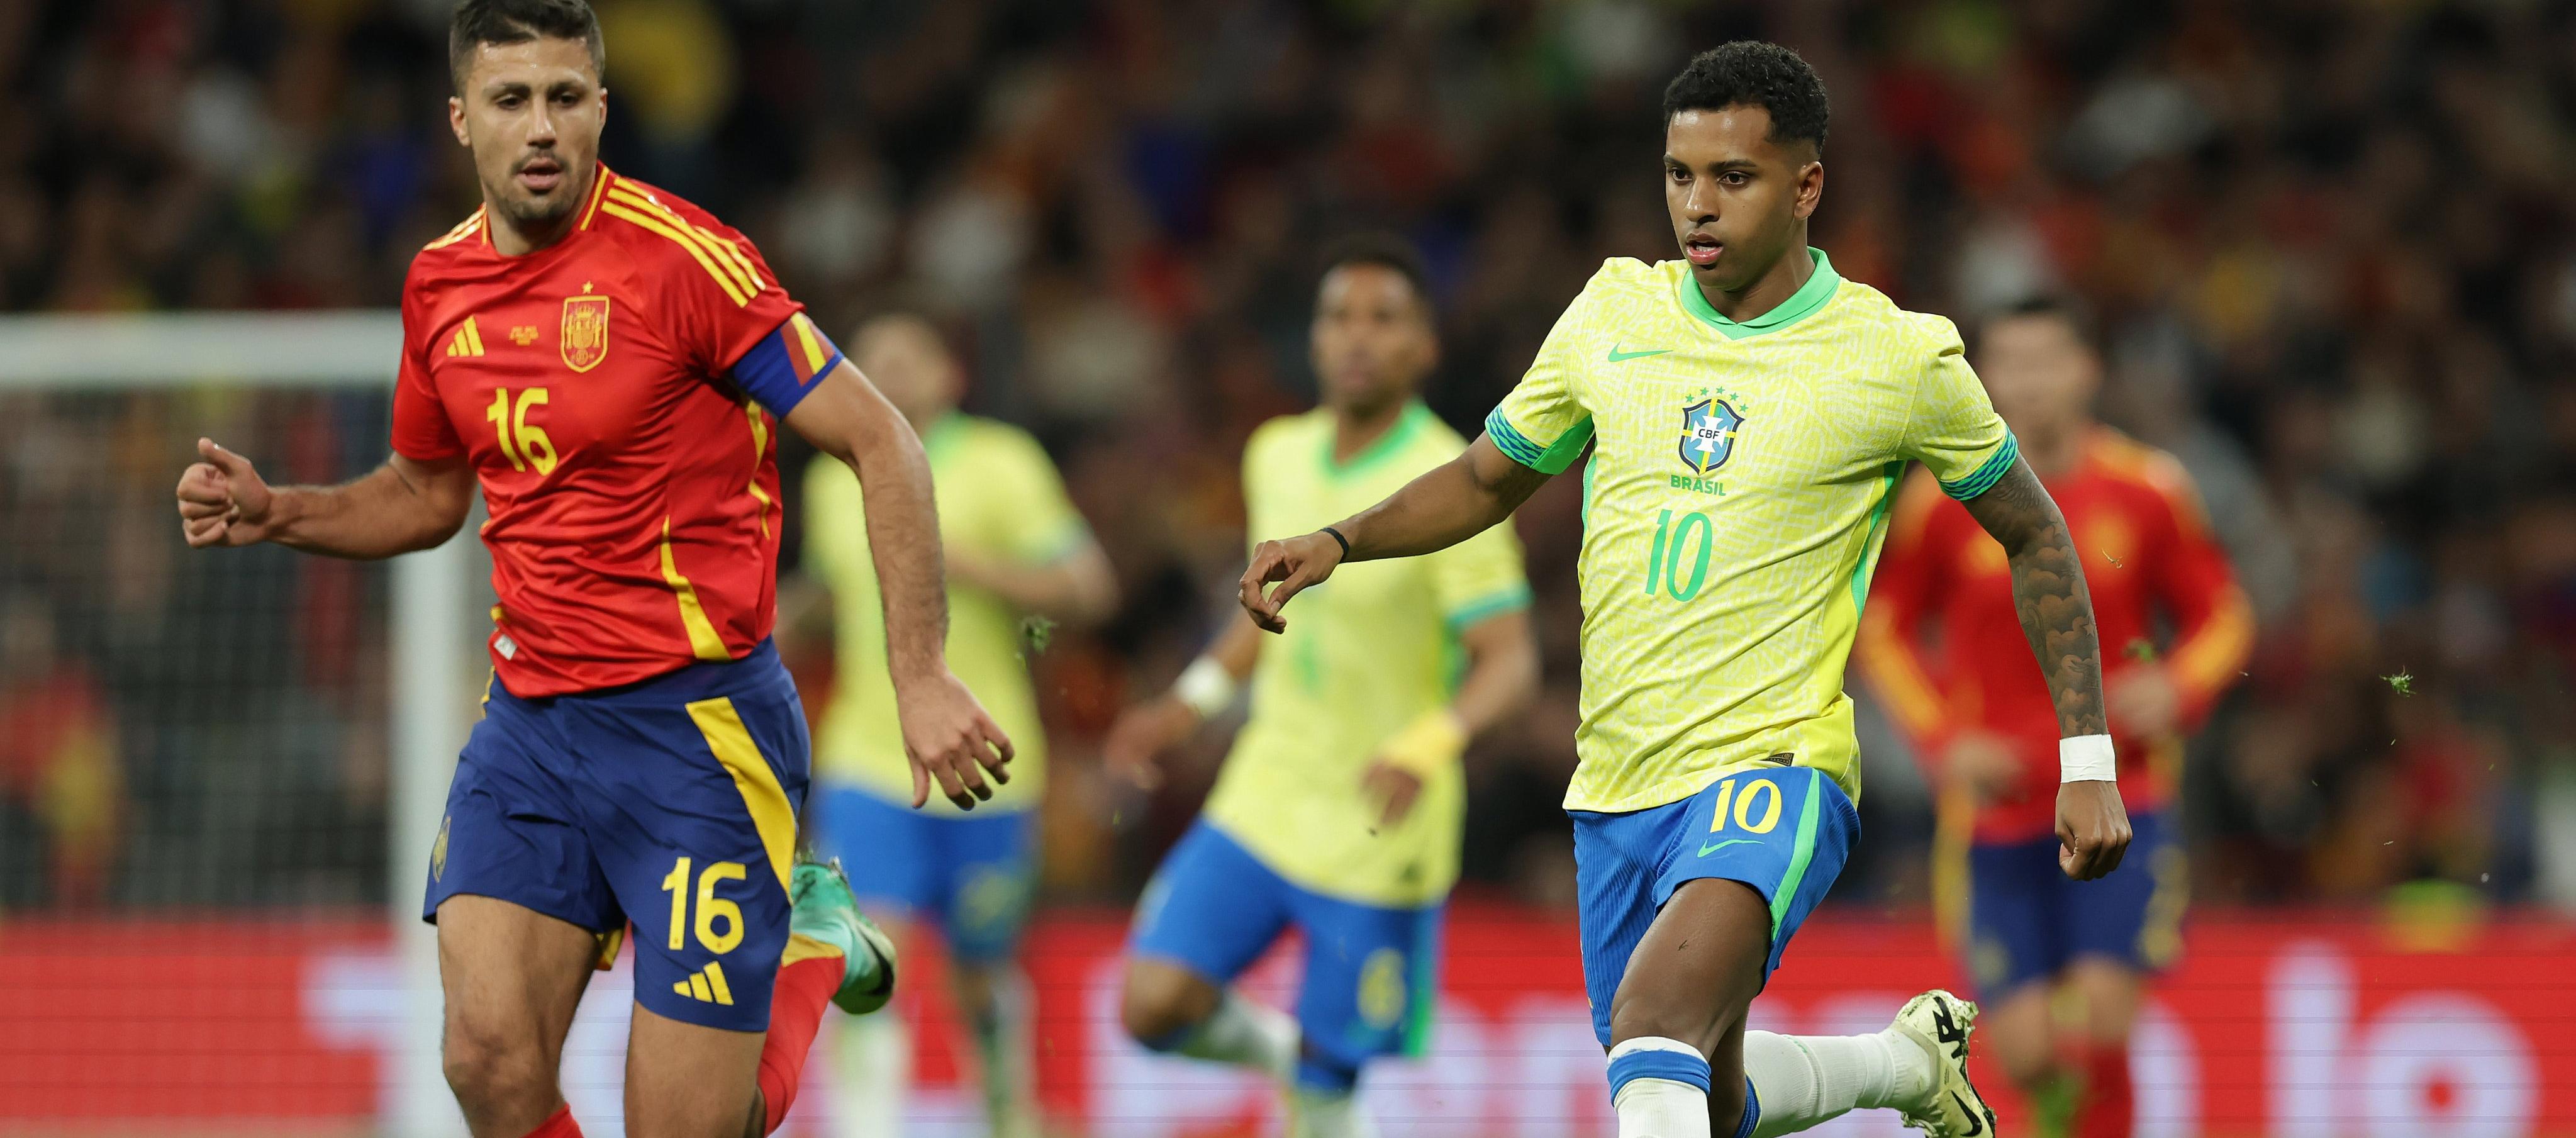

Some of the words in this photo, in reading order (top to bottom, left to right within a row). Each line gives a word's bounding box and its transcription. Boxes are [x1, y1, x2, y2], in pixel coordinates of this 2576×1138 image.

[486, 387, 557, 476] 16
[1698, 428, 1720, 439] CBF
[1671, 474, 1726, 496] BRASIL
[1645, 509, 1712, 602] 10
[1710, 779, 1782, 834] 10
[662, 856, 747, 954] 16
